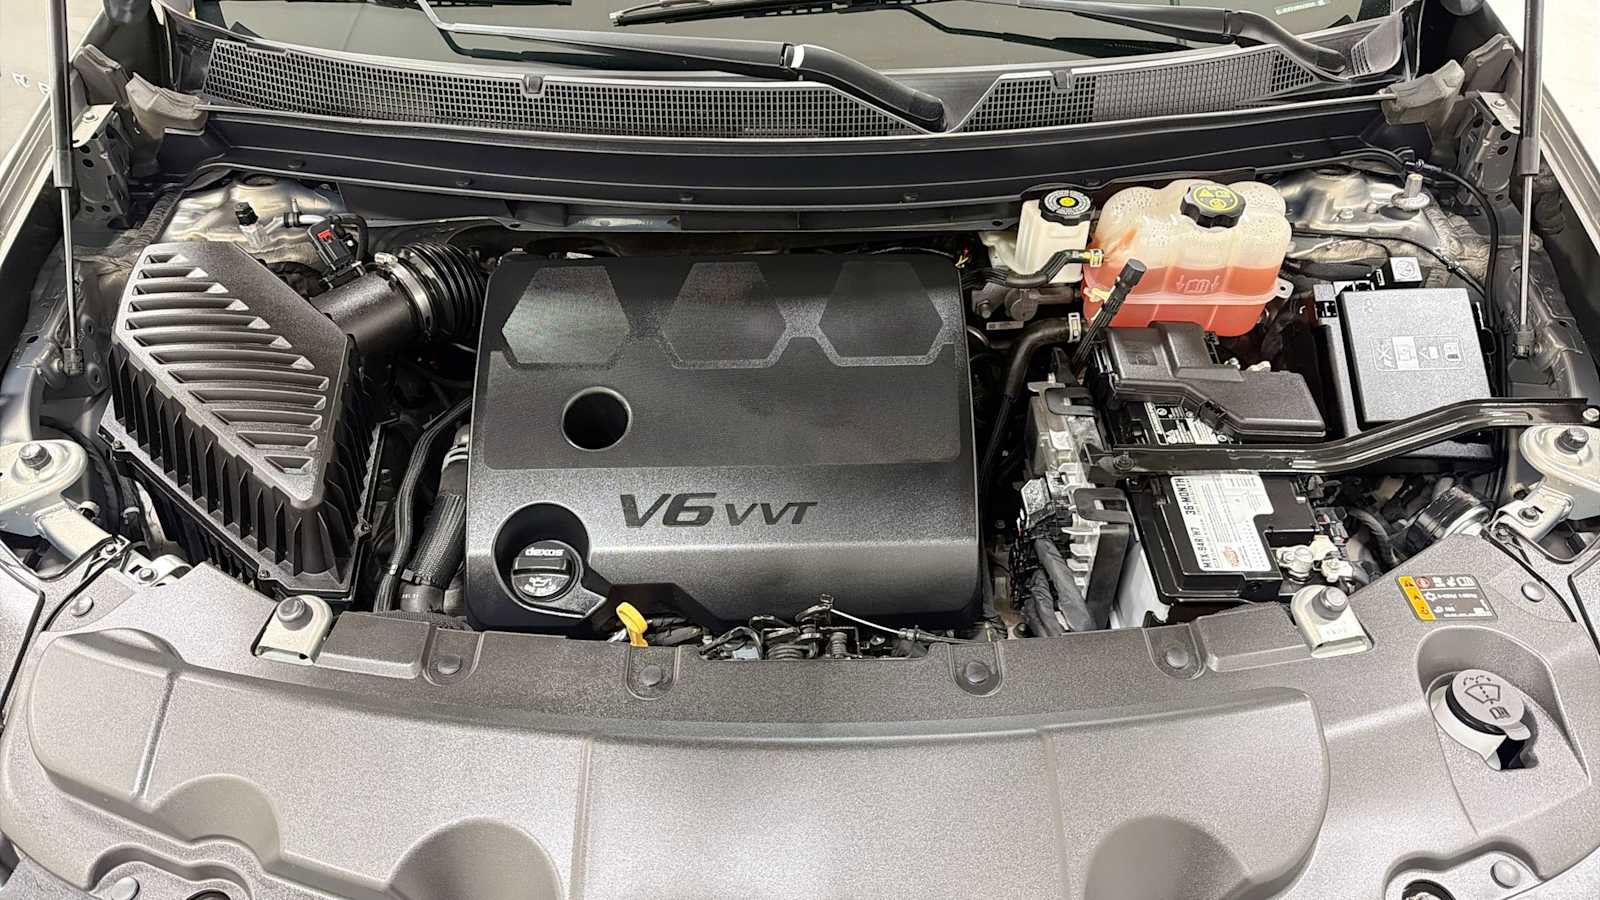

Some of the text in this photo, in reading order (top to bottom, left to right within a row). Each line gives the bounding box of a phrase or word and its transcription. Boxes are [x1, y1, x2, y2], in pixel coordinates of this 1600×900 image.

[620, 492, 818, 528] V6 VVT
[1173, 478, 1196, 515] 36-MONTH
[525, 547, 565, 556] dexos
